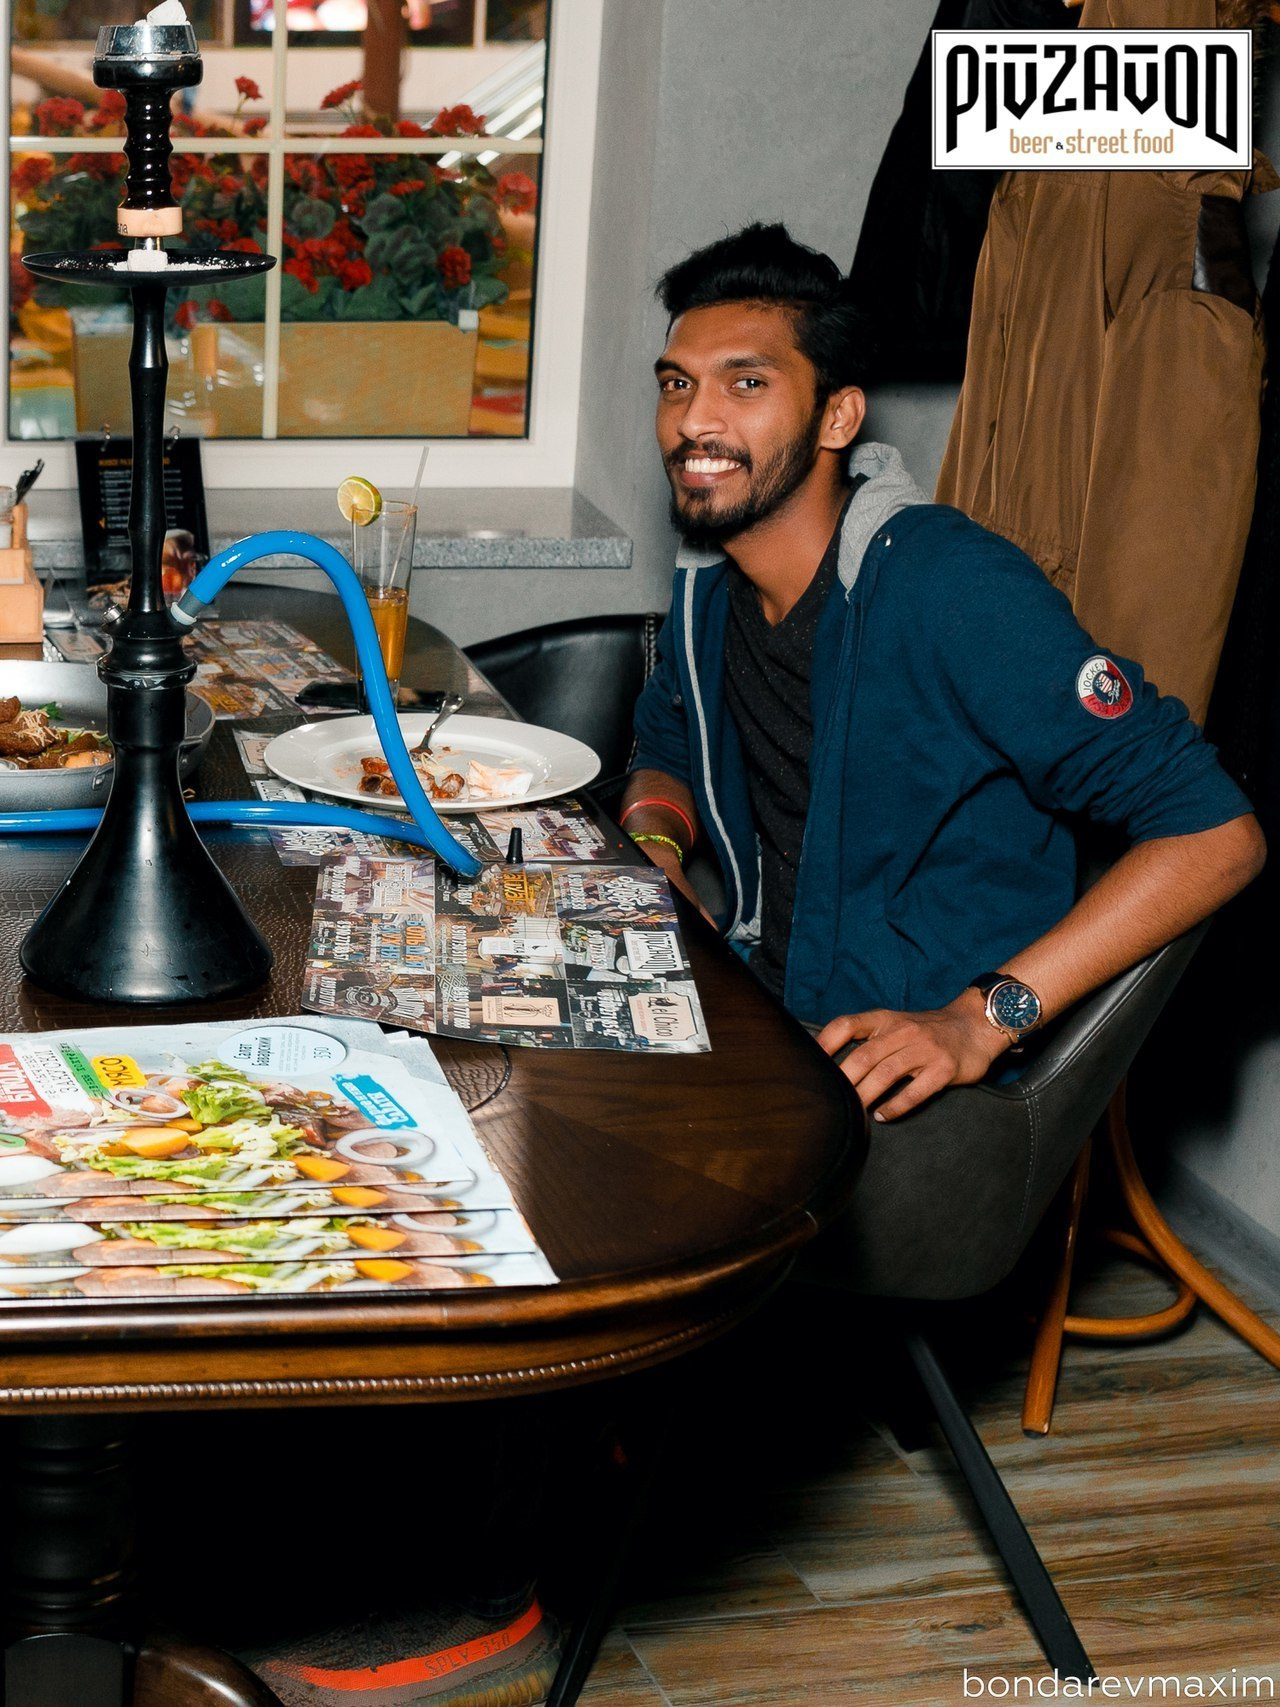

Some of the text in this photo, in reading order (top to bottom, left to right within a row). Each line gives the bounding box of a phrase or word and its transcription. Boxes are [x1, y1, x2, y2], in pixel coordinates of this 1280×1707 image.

[1083, 662, 1105, 692] JOCKEY
[379, 926, 400, 959] КУХНЯ
[403, 919, 426, 969] БОЛЬШАЯ
[511, 939, 524, 953] UTKA
[651, 1007, 679, 1037] el Chico
[233, 1043, 252, 1060] Салат
[252, 1036, 275, 1067] Баварский
[313, 1046, 331, 1059] 350
[34, 1048, 79, 1095] ЗАКУСКИ
[99, 1057, 137, 1088] МЯСО
[422, 1631, 512, 1677] SPLY-350
